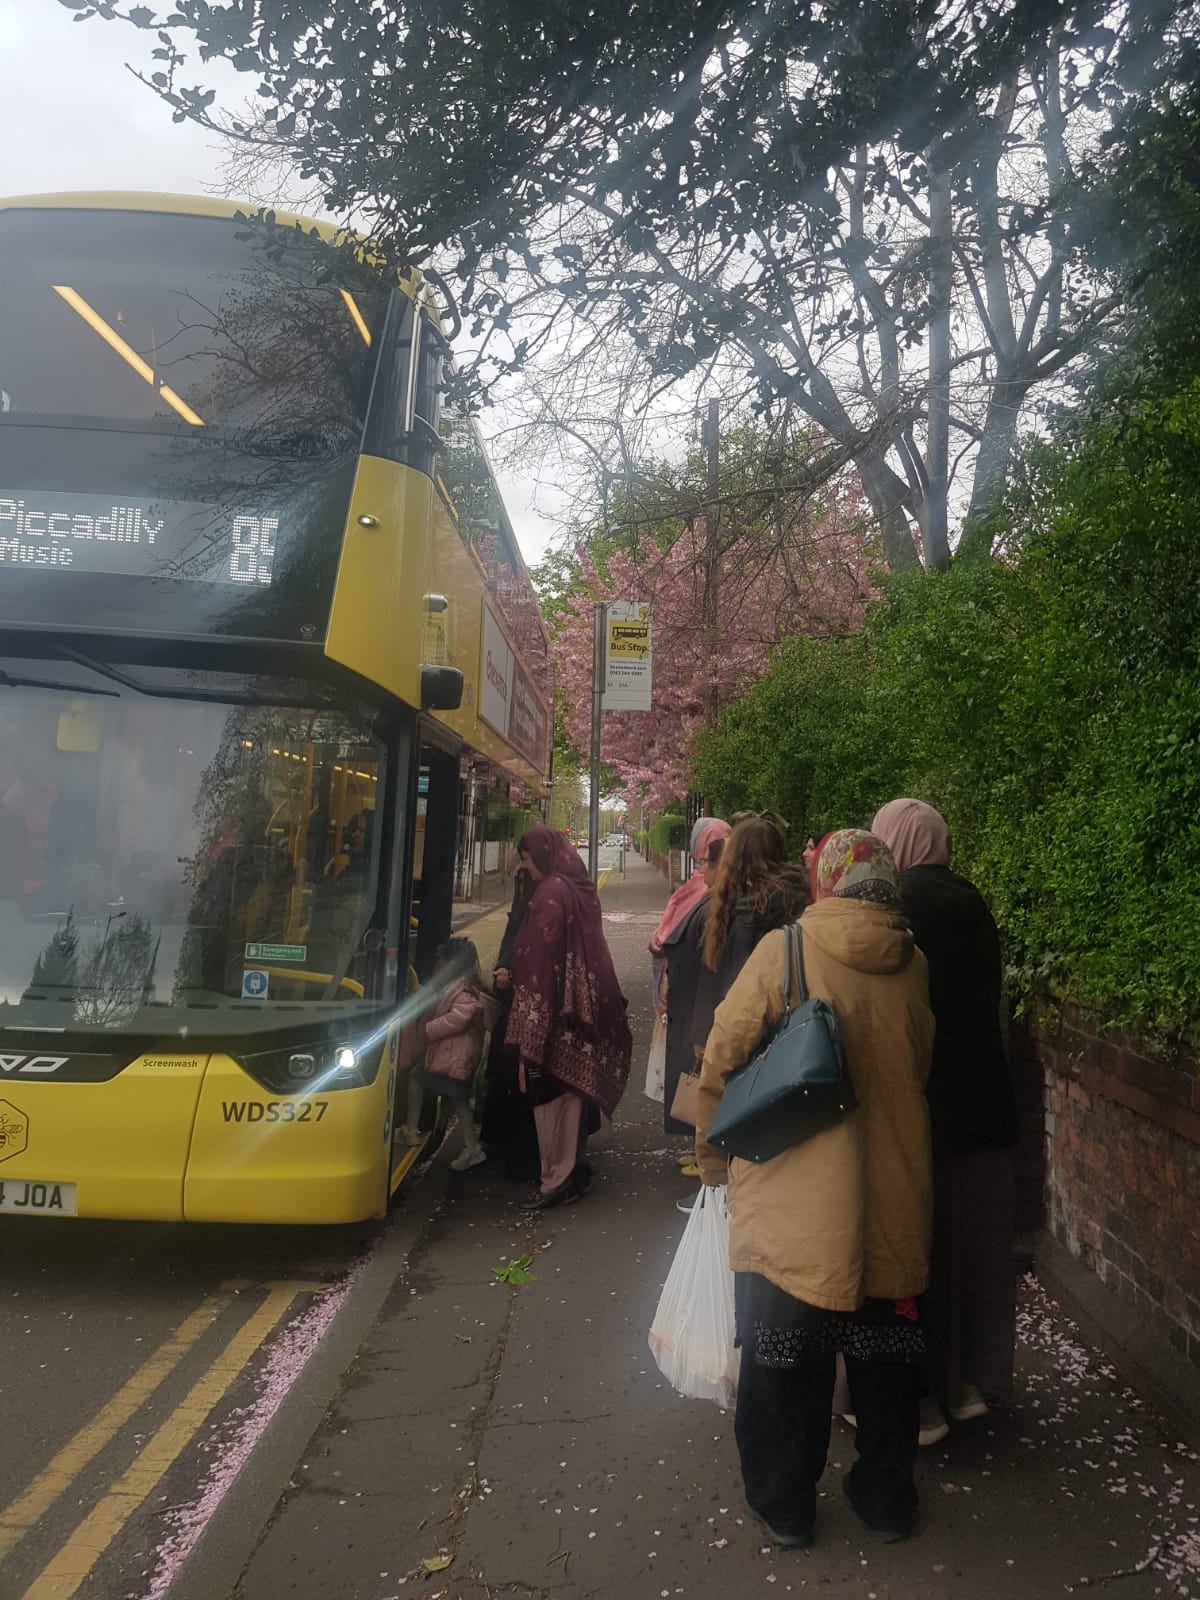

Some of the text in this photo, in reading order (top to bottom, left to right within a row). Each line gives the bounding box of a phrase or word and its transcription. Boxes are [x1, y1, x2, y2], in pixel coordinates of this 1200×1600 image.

[0, 499, 164, 544] Piccadilly
[0, 536, 73, 565] Music
[610, 642, 648, 654] Bus Stop
[142, 1058, 198, 1068] Screenwash
[222, 1101, 329, 1123] WDS327
[14, 1183, 63, 1209] JOA
